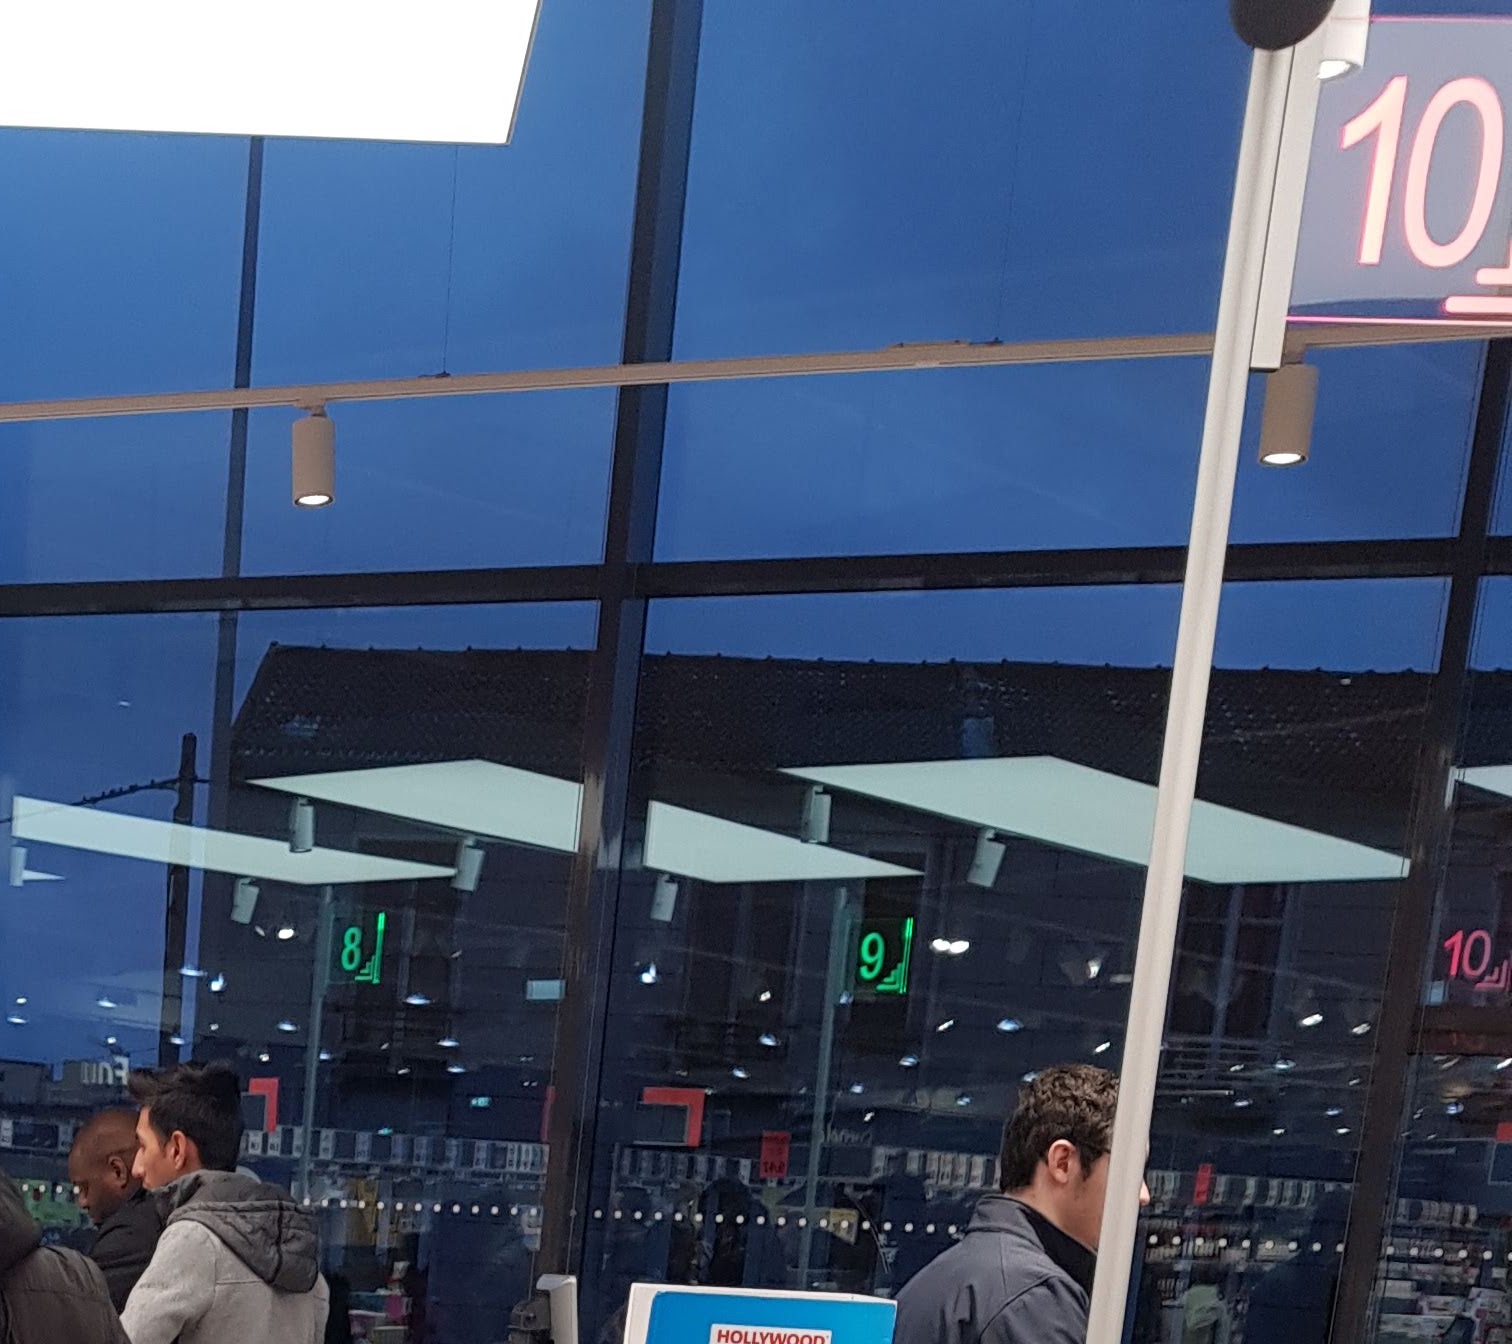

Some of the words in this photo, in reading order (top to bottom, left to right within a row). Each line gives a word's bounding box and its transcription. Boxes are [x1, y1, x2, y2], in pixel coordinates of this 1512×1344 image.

[1339, 74, 1504, 269] 10
[340, 926, 363, 971] 8
[858, 931, 887, 981] 9
[1443, 929, 1491, 978] 10
